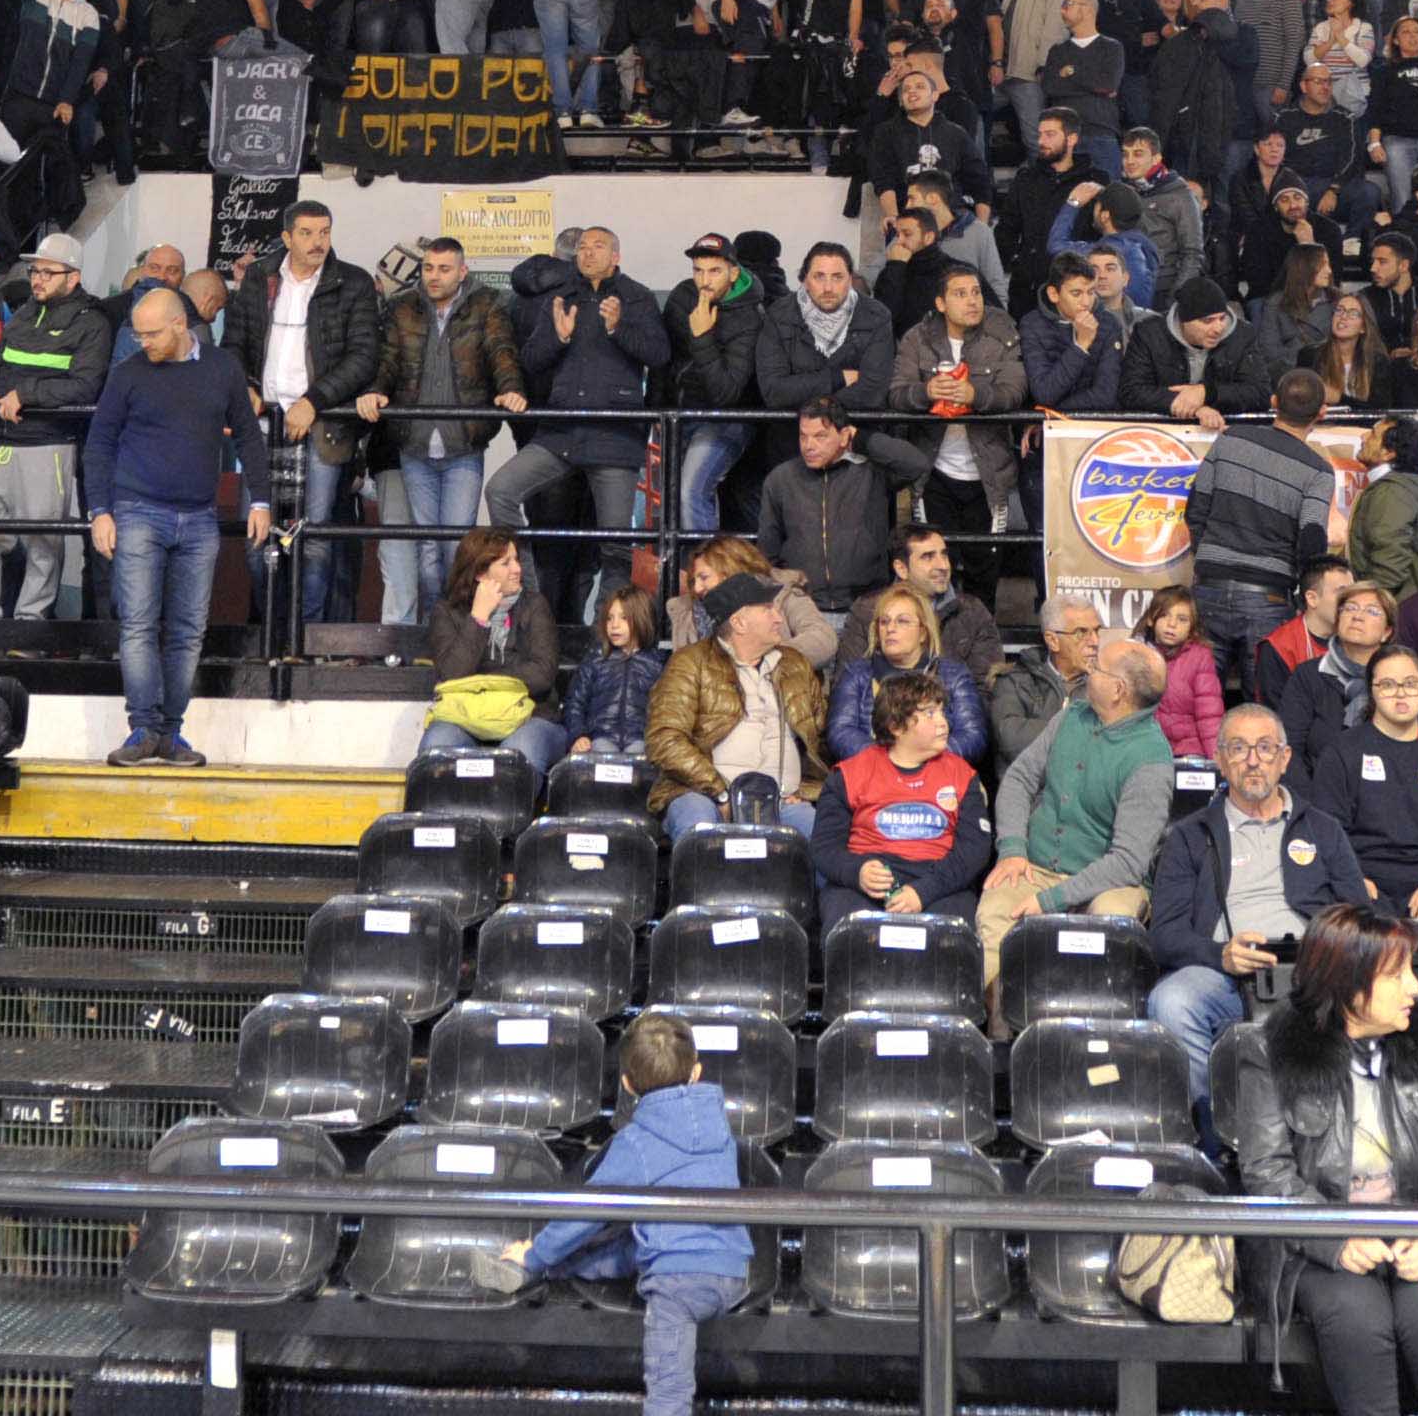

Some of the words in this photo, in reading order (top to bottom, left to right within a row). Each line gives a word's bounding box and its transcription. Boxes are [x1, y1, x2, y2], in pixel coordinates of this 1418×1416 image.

[237, 62, 288, 79] JACK
[342, 55, 461, 100] SOLO
[252, 84, 268, 100] &
[234, 103, 282, 123] COCA
[445, 209, 487, 227] DAVIDE
[492, 209, 551, 227] ANCILOTTO
[1086, 466, 1197, 490] basket
[1057, 575, 1122, 588] PROGETTO
[165, 922, 189, 934] FILA
[197, 915, 210, 935] G
[12, 1104, 40, 1122] FILA
[50, 1098, 65, 1124] E
